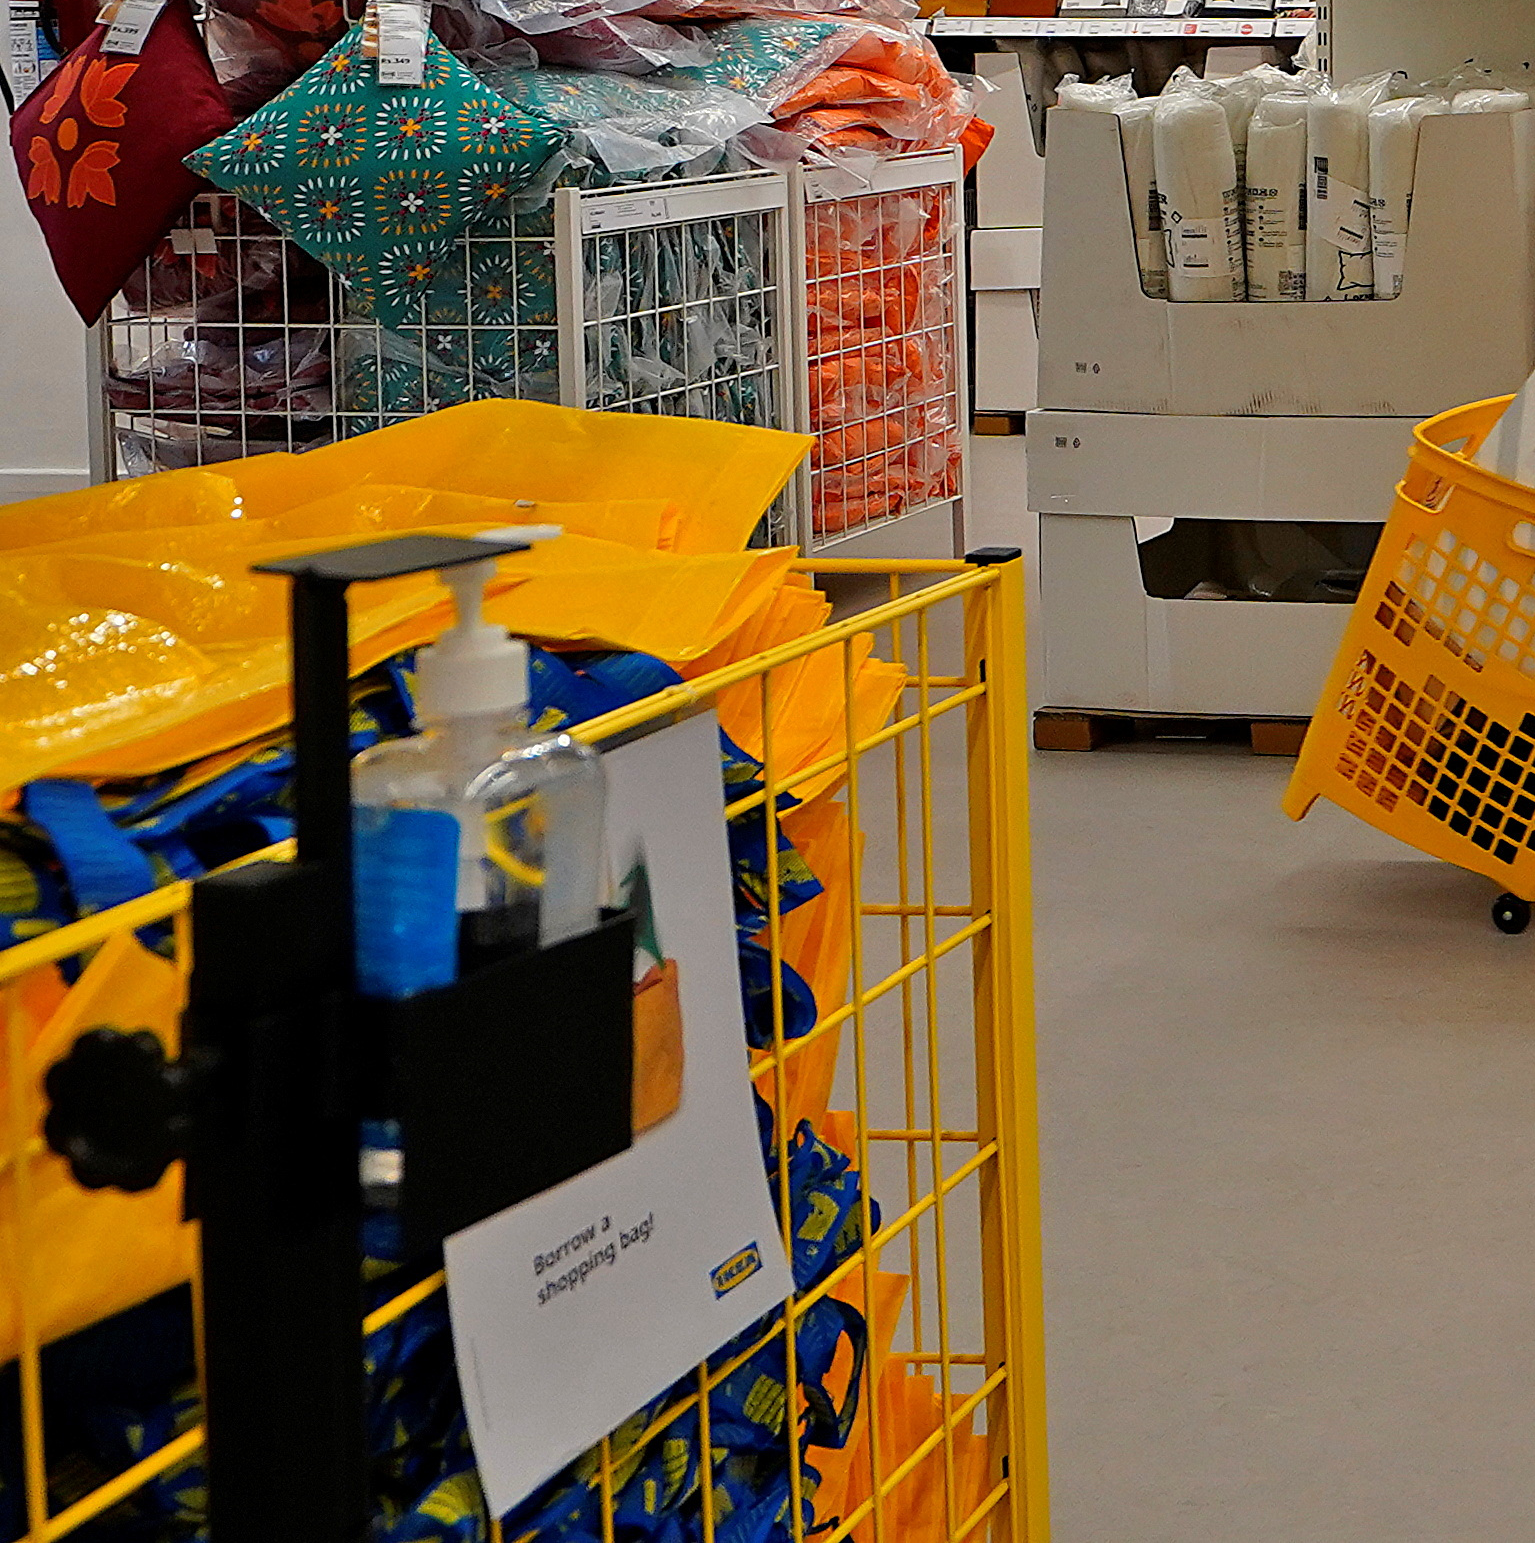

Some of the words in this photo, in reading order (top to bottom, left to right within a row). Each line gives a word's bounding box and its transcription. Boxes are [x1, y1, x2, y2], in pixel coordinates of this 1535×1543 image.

[533, 1224, 597, 1276] Borrow
[601, 1215, 611, 1233] a
[537, 1241, 617, 1306] shopping
[619, 1211, 654, 1251] bag!
